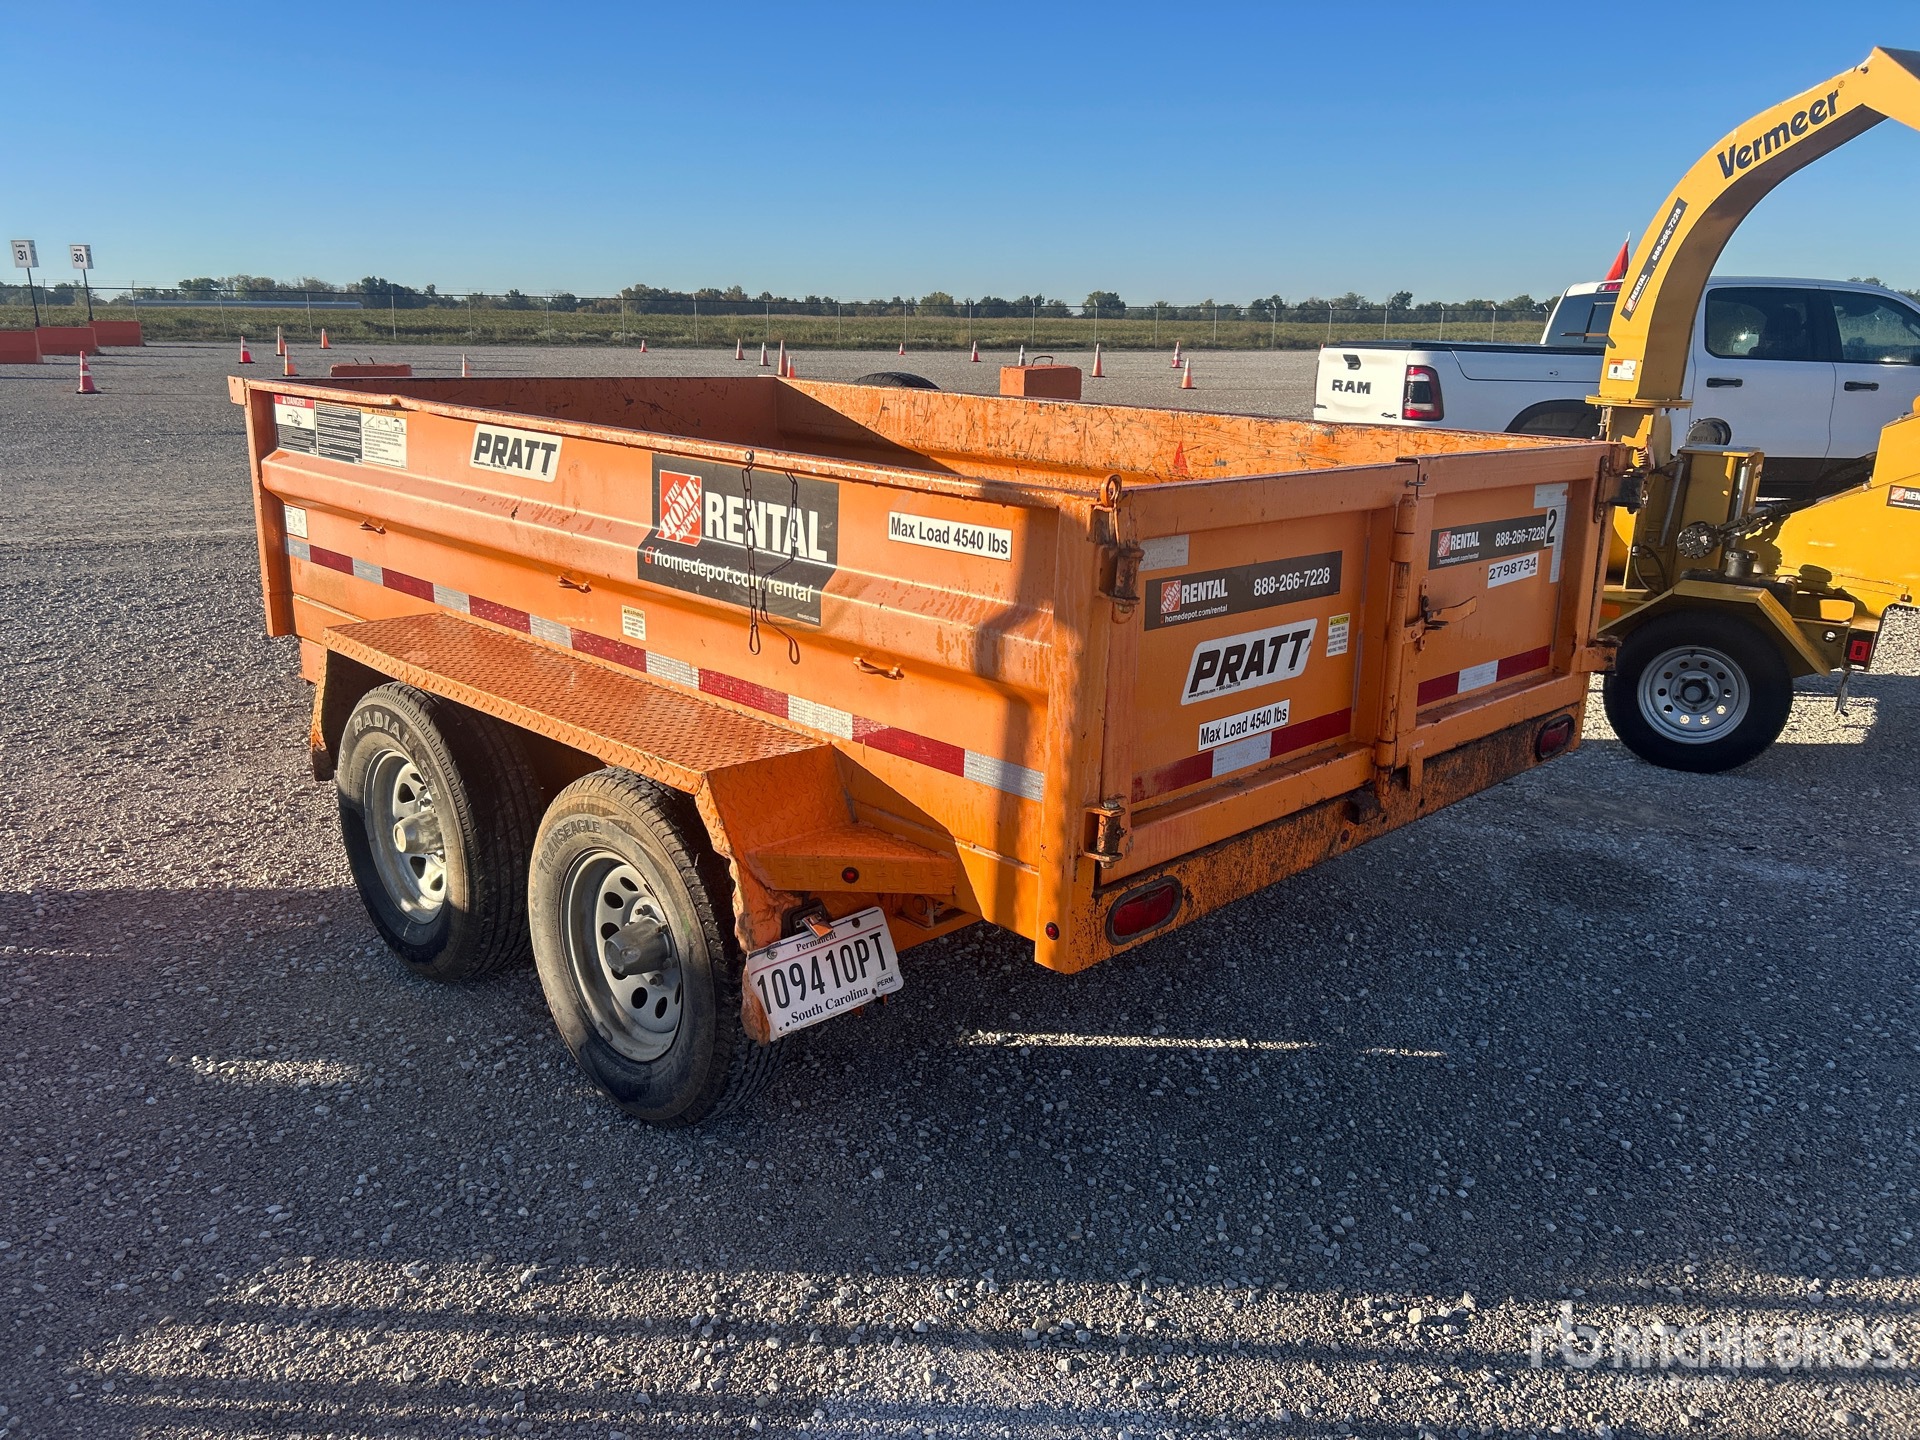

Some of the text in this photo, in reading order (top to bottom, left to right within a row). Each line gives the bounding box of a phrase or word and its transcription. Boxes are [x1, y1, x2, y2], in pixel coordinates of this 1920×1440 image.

[1717, 88, 1840, 180] Vermeer
[17, 250, 28, 261] 31
[73, 253, 85, 263] 30
[1630, 274, 1648, 301] RENTAL
[1331, 379, 1372, 395] RAM
[473, 431, 558, 474] PRATT
[657, 475, 702, 540] HOME
[664, 480, 682, 508] THE
[674, 503, 702, 541] DEPOT
[704, 491, 828, 563] RENTAL
[891, 516, 1008, 555] Max Load 4540 lbs
[1450, 531, 1480, 551] RENTAL
[1495, 526, 1545, 548] 888-266-7228
[1546, 508, 1558, 544] 2
[1181, 566, 1331, 605] RENTAL 888-266-7228
[1488, 556, 1537, 581] 2798734
[1160, 580, 1181, 613] HOME
[1164, 604, 1228, 624] homedepot.com/rental
[1188, 628, 1312, 694] PRATT
[354, 710, 411, 752] RADIAL
[1200, 706, 1288, 746] Max Load 4540 lbs
[539, 819, 603, 875] TRANSEAGLE
[796, 932, 838, 952] Permanent
[757, 932, 887, 1015] 109410PT
[876, 975, 895, 988] PERM
[791, 987, 869, 1024] South Carolina
